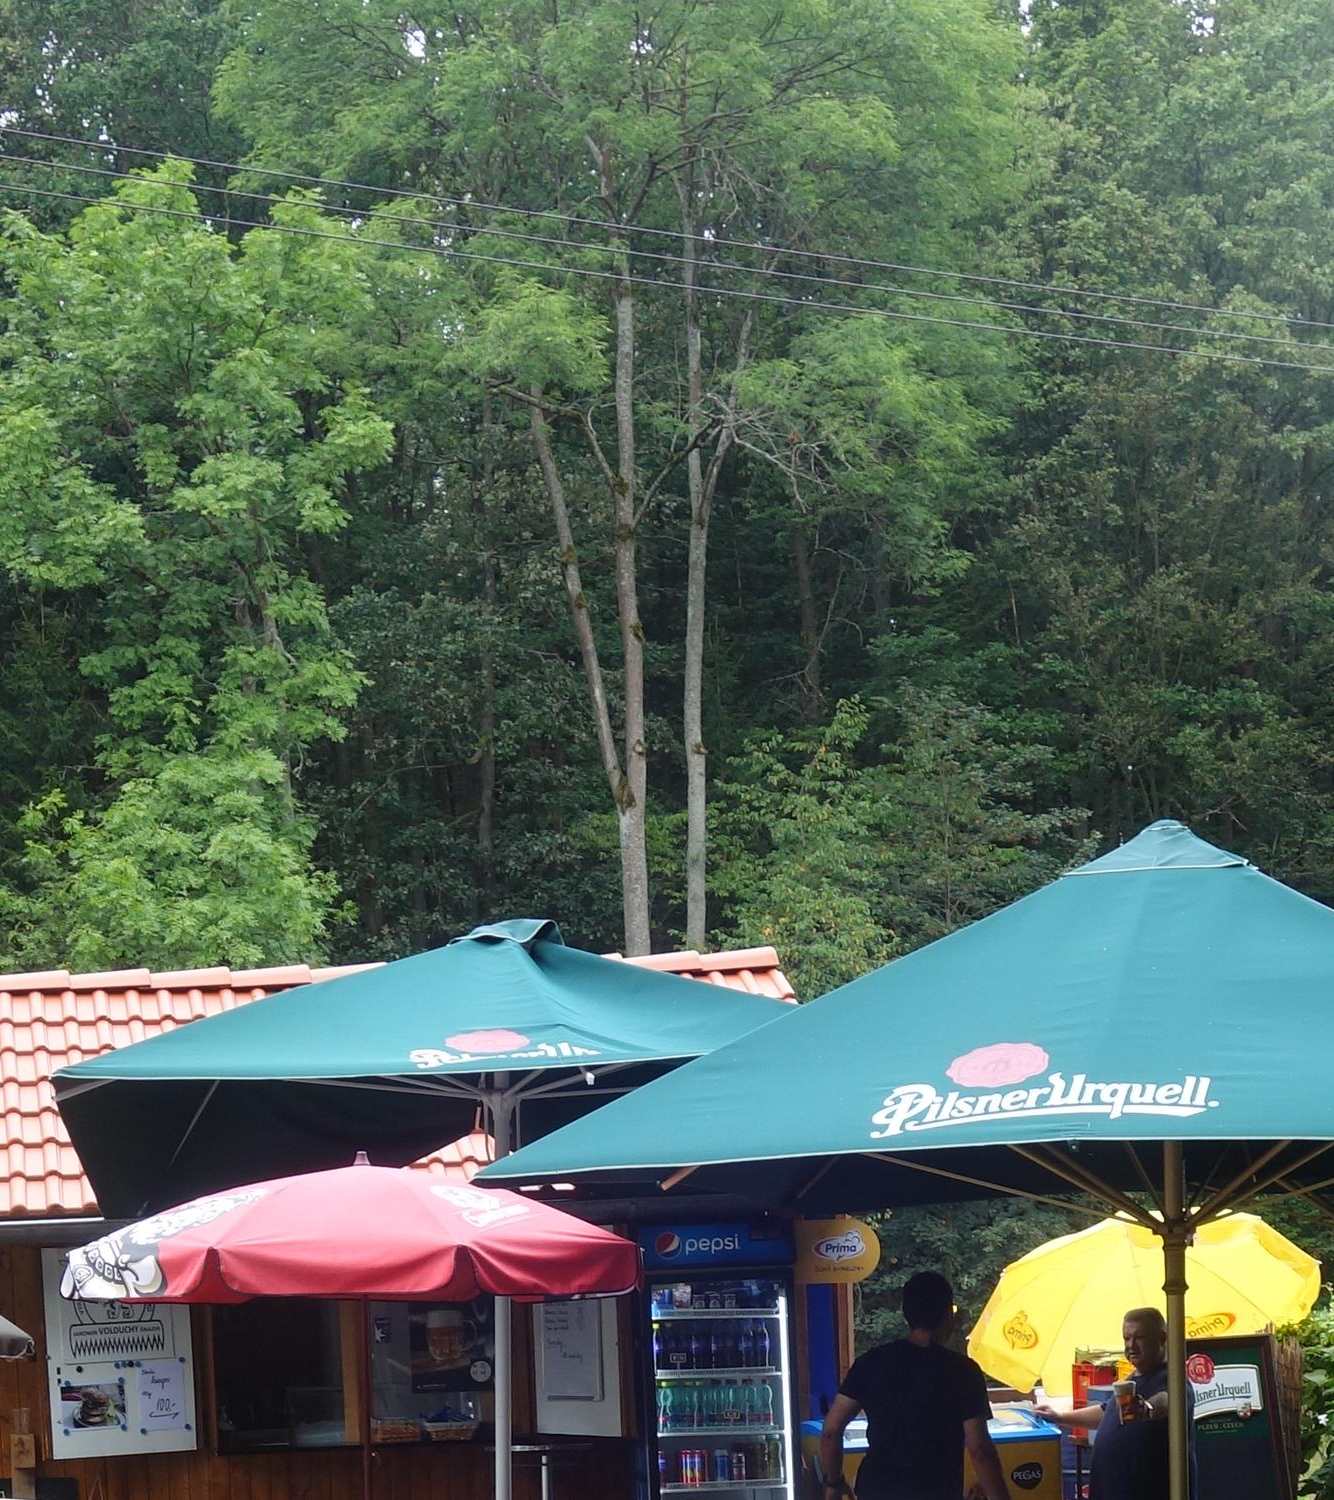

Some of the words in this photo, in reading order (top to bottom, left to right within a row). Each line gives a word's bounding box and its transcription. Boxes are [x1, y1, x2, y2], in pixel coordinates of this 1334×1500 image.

[685, 1233, 740, 1255] pepsi
[825, 1243, 857, 1254] Prima
[98, 1325, 139, 1335] VOLDUCHY
[1013, 1470, 1042, 1481] PEGAS
